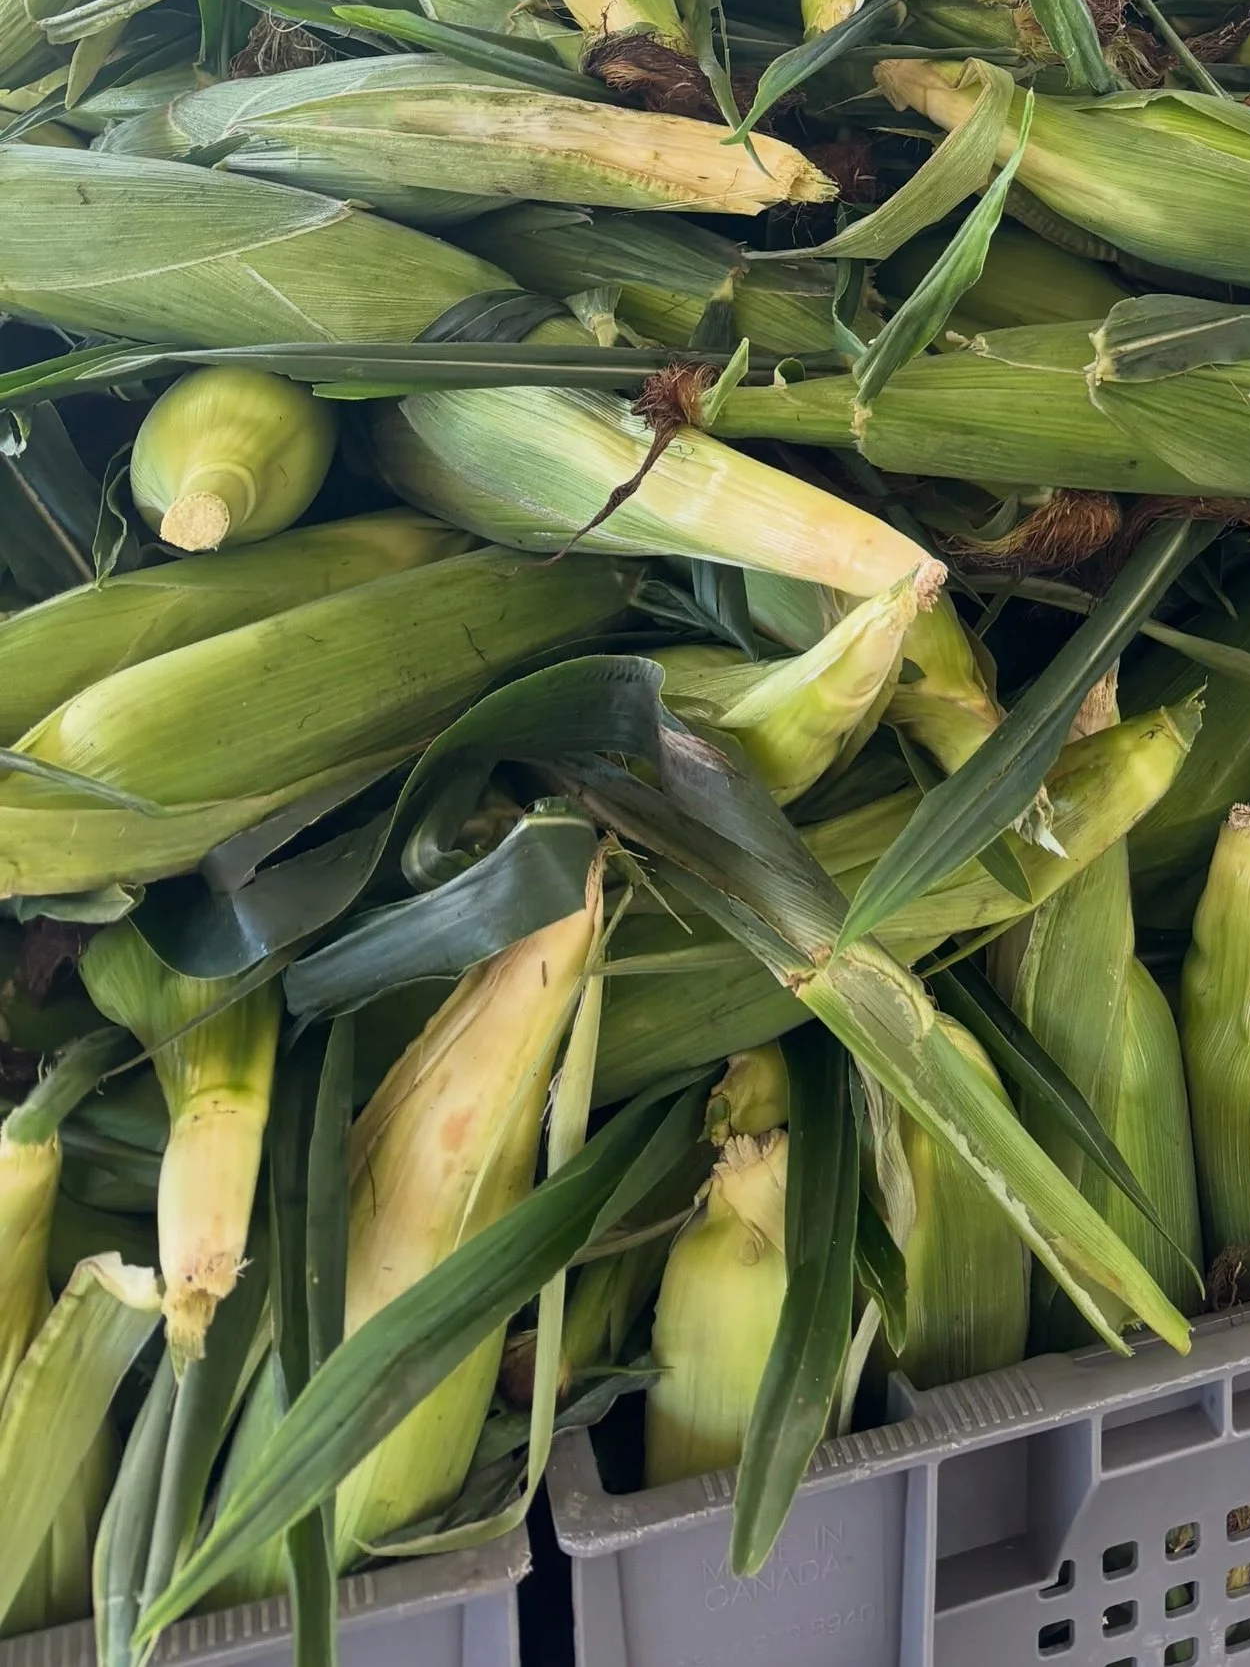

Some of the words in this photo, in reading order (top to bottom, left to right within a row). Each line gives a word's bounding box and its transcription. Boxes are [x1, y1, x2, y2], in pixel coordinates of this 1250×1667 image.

[702, 1541, 793, 1585] ME
[815, 1519, 844, 1551] IN
[704, 1555, 843, 1612] CANADA
